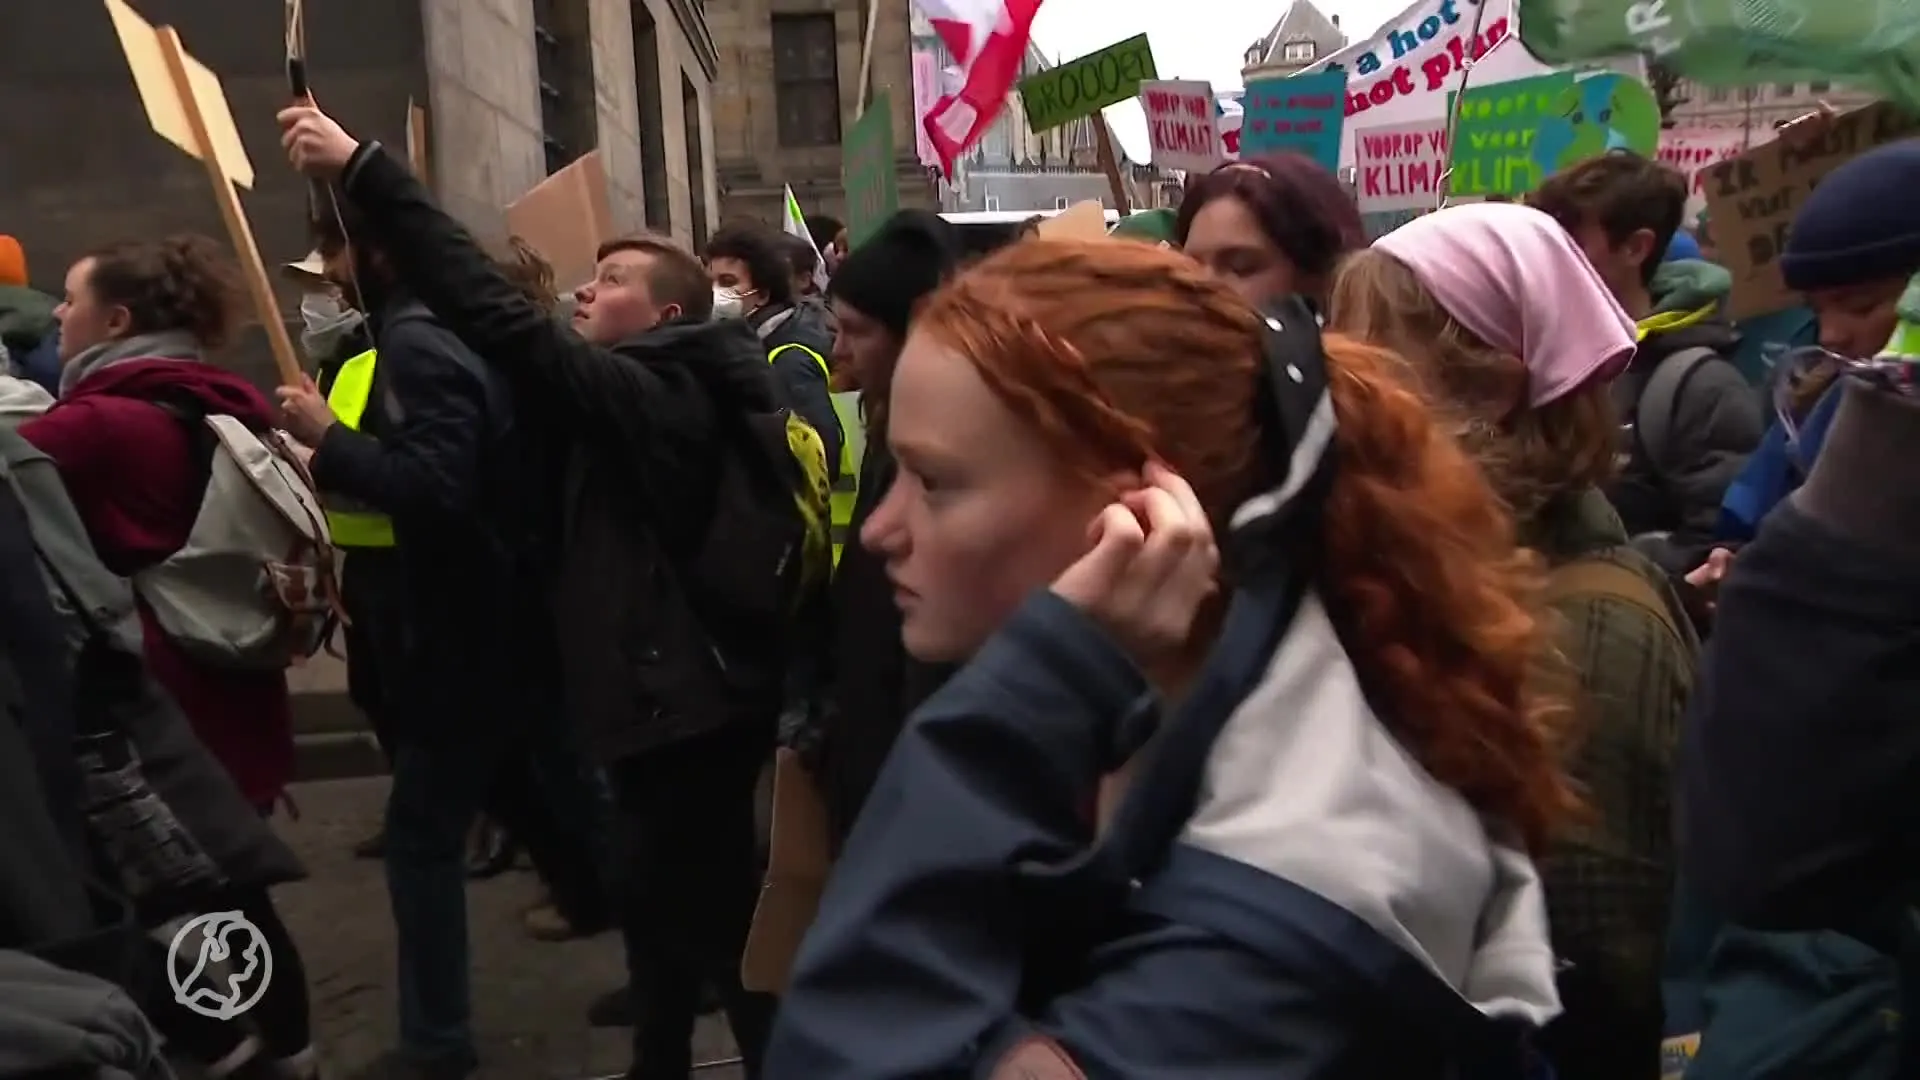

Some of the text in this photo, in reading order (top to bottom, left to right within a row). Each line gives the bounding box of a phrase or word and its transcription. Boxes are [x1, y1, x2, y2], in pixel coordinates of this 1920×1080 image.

[1356, 51, 1381, 76] a
[1387, 0, 1461, 59] hot
[1363, 132, 1424, 160] VOOROP
